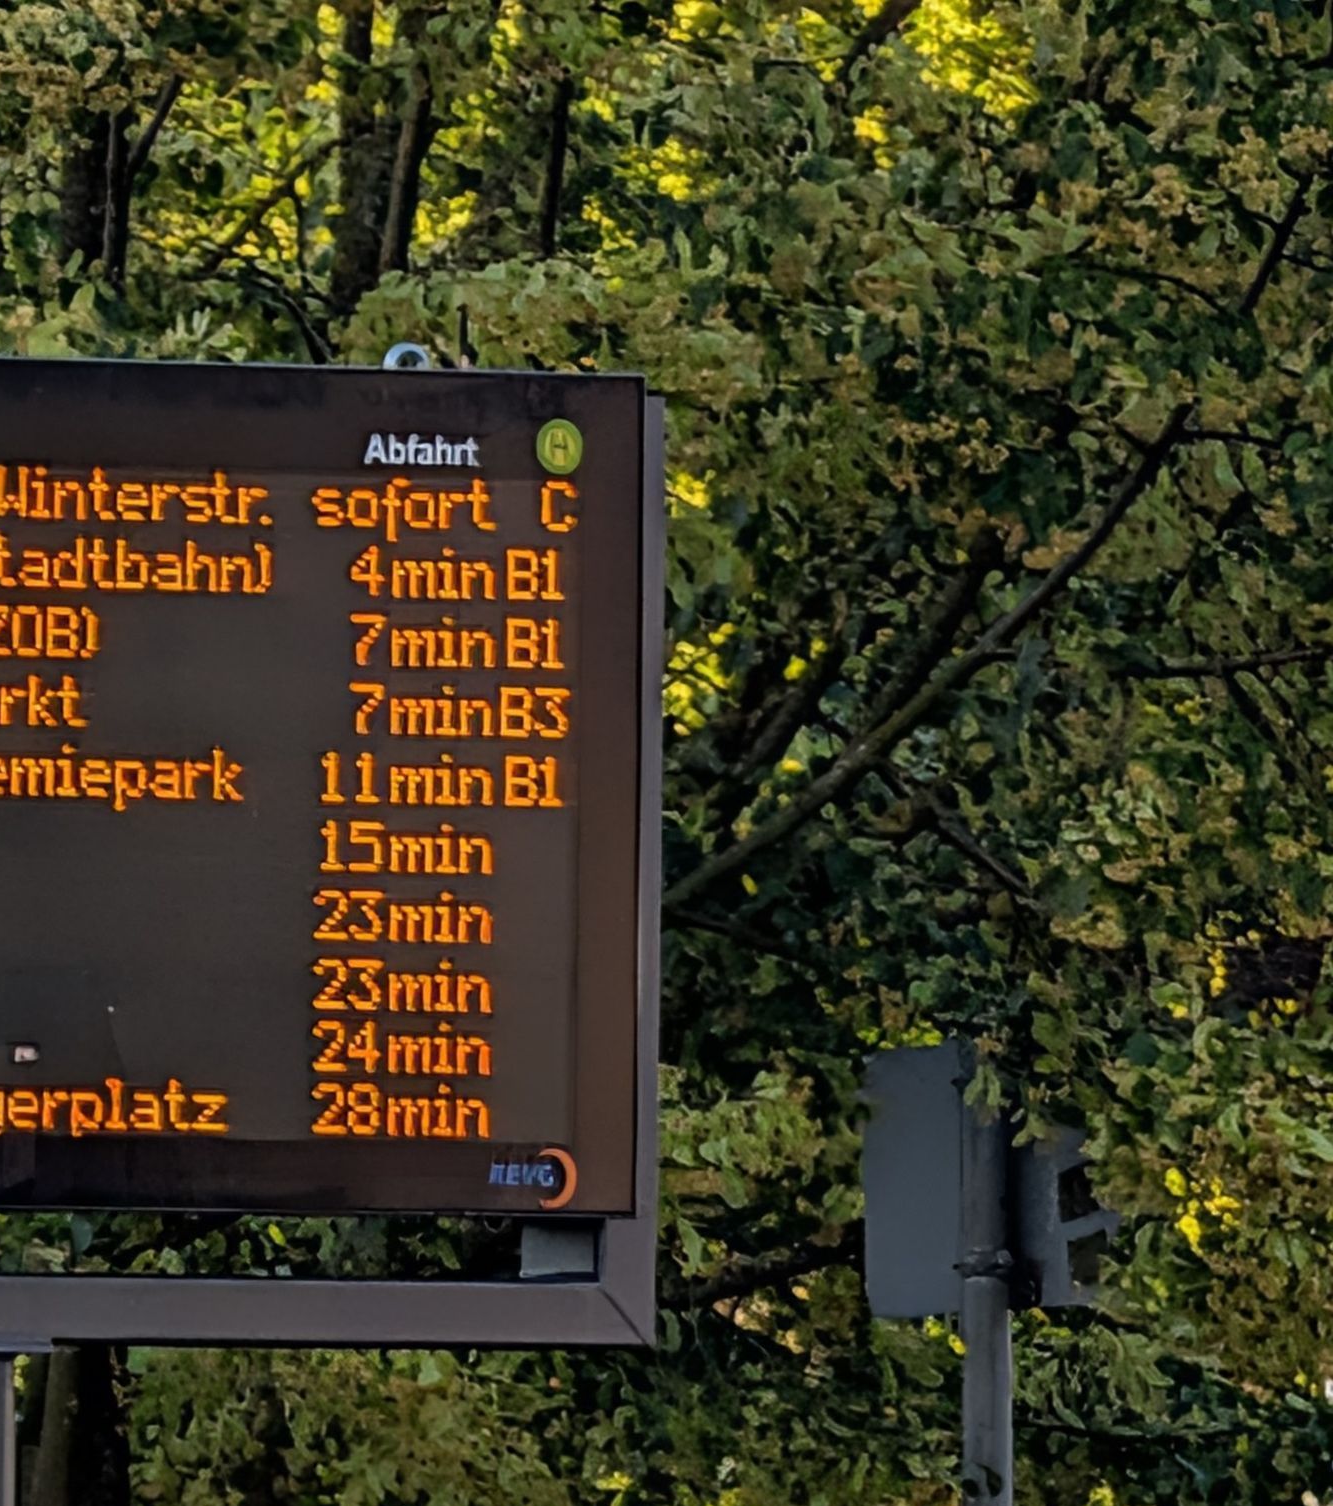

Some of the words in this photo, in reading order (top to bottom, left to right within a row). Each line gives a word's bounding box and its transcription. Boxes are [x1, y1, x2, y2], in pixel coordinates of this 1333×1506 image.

[364, 433, 479, 467] Abfahrt
[311, 477, 496, 543] sofort
[541, 480, 577, 533] C
